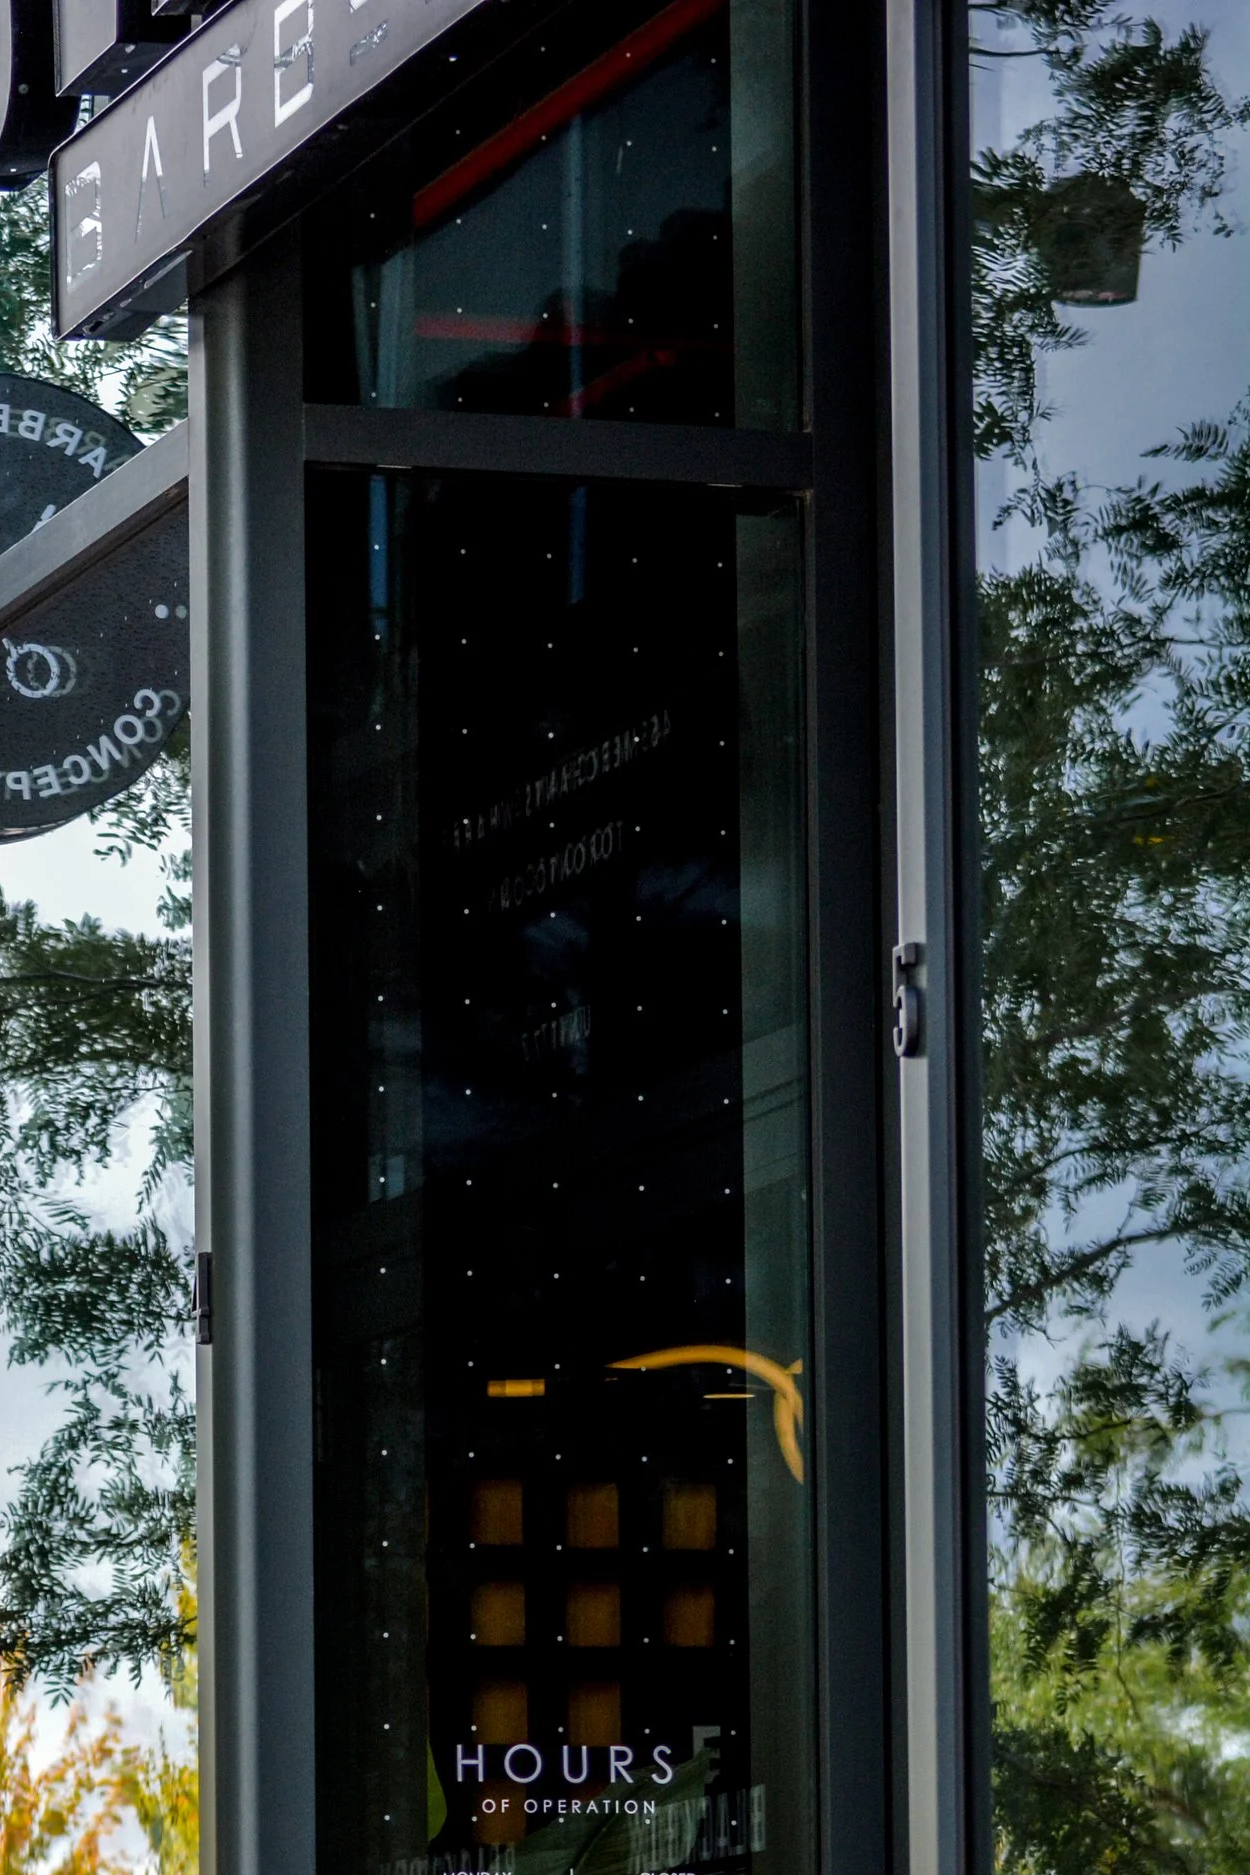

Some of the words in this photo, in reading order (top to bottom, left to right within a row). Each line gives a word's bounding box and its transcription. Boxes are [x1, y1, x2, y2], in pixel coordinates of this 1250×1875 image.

[455, 1743, 673, 1785] HOURS
[481, 1798, 511, 1814] OF
[523, 1799, 656, 1815] OPERATION
